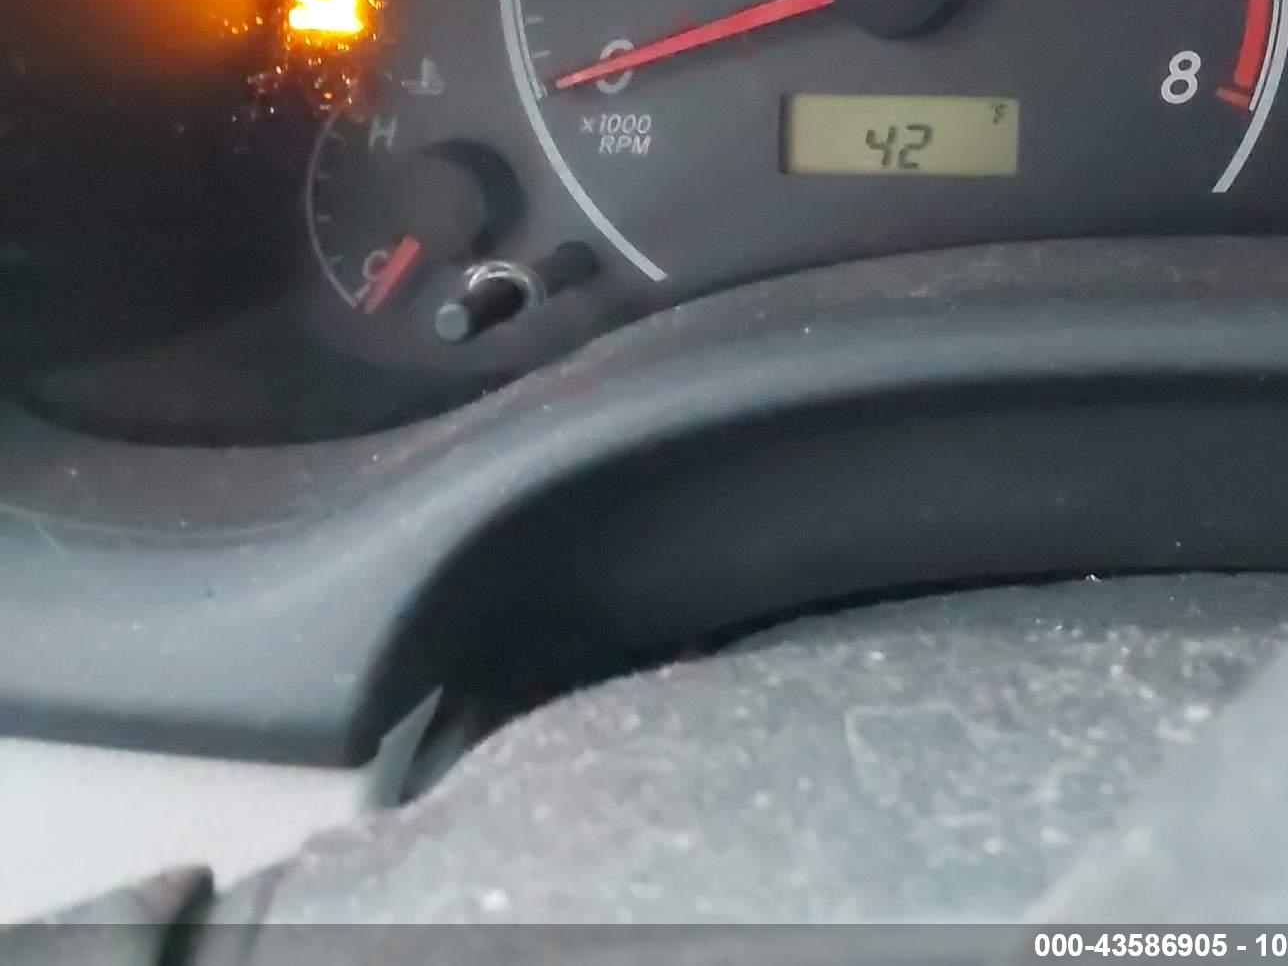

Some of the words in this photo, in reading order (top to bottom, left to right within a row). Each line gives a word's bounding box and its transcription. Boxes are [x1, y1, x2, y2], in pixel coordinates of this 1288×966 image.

[1161, 50, 1201, 104] 8
[368, 115, 398, 149] H
[599, 135, 652, 155] RPM
[865, 124, 933, 168] 42
